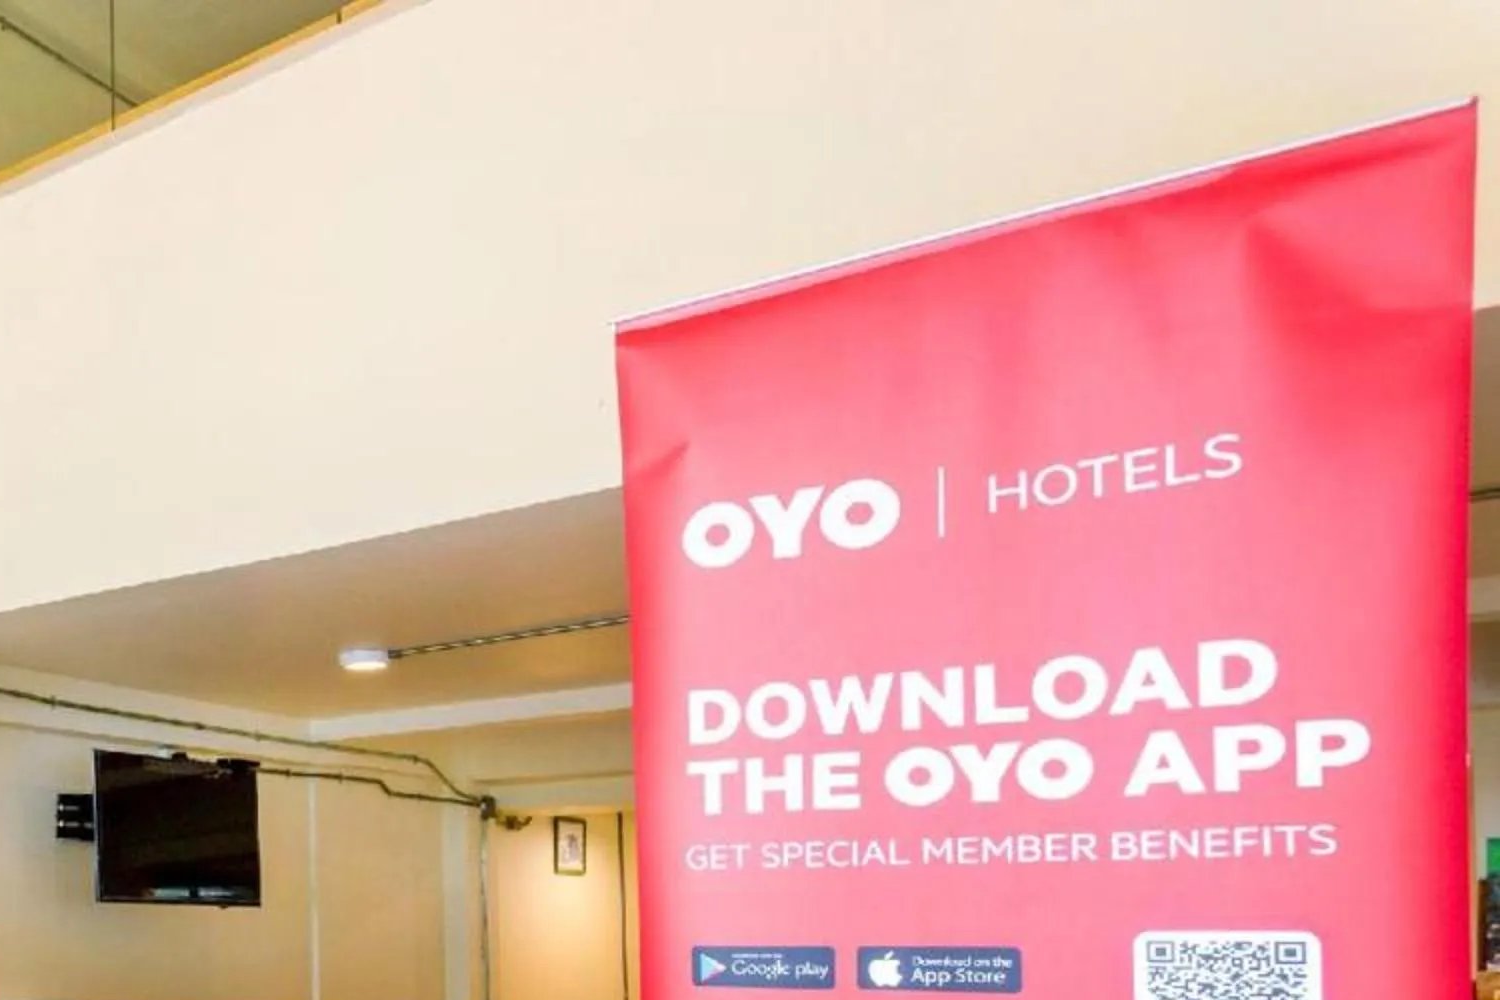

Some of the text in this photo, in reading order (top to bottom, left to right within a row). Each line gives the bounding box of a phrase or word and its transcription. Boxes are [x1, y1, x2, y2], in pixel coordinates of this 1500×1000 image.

[682, 433, 1244, 569] OYO HOTELS
[687, 638, 1278, 746] DOWNLOAD
[686, 719, 1371, 816] THE OYO APP
[685, 823, 1338, 872] GET SPECIAL MEMBER BENEFITS
[731, 959, 829, 979] Google play
[911, 968, 1007, 986] App Store
[912, 956, 971, 967] Download
[991, 957, 1013, 969] the
